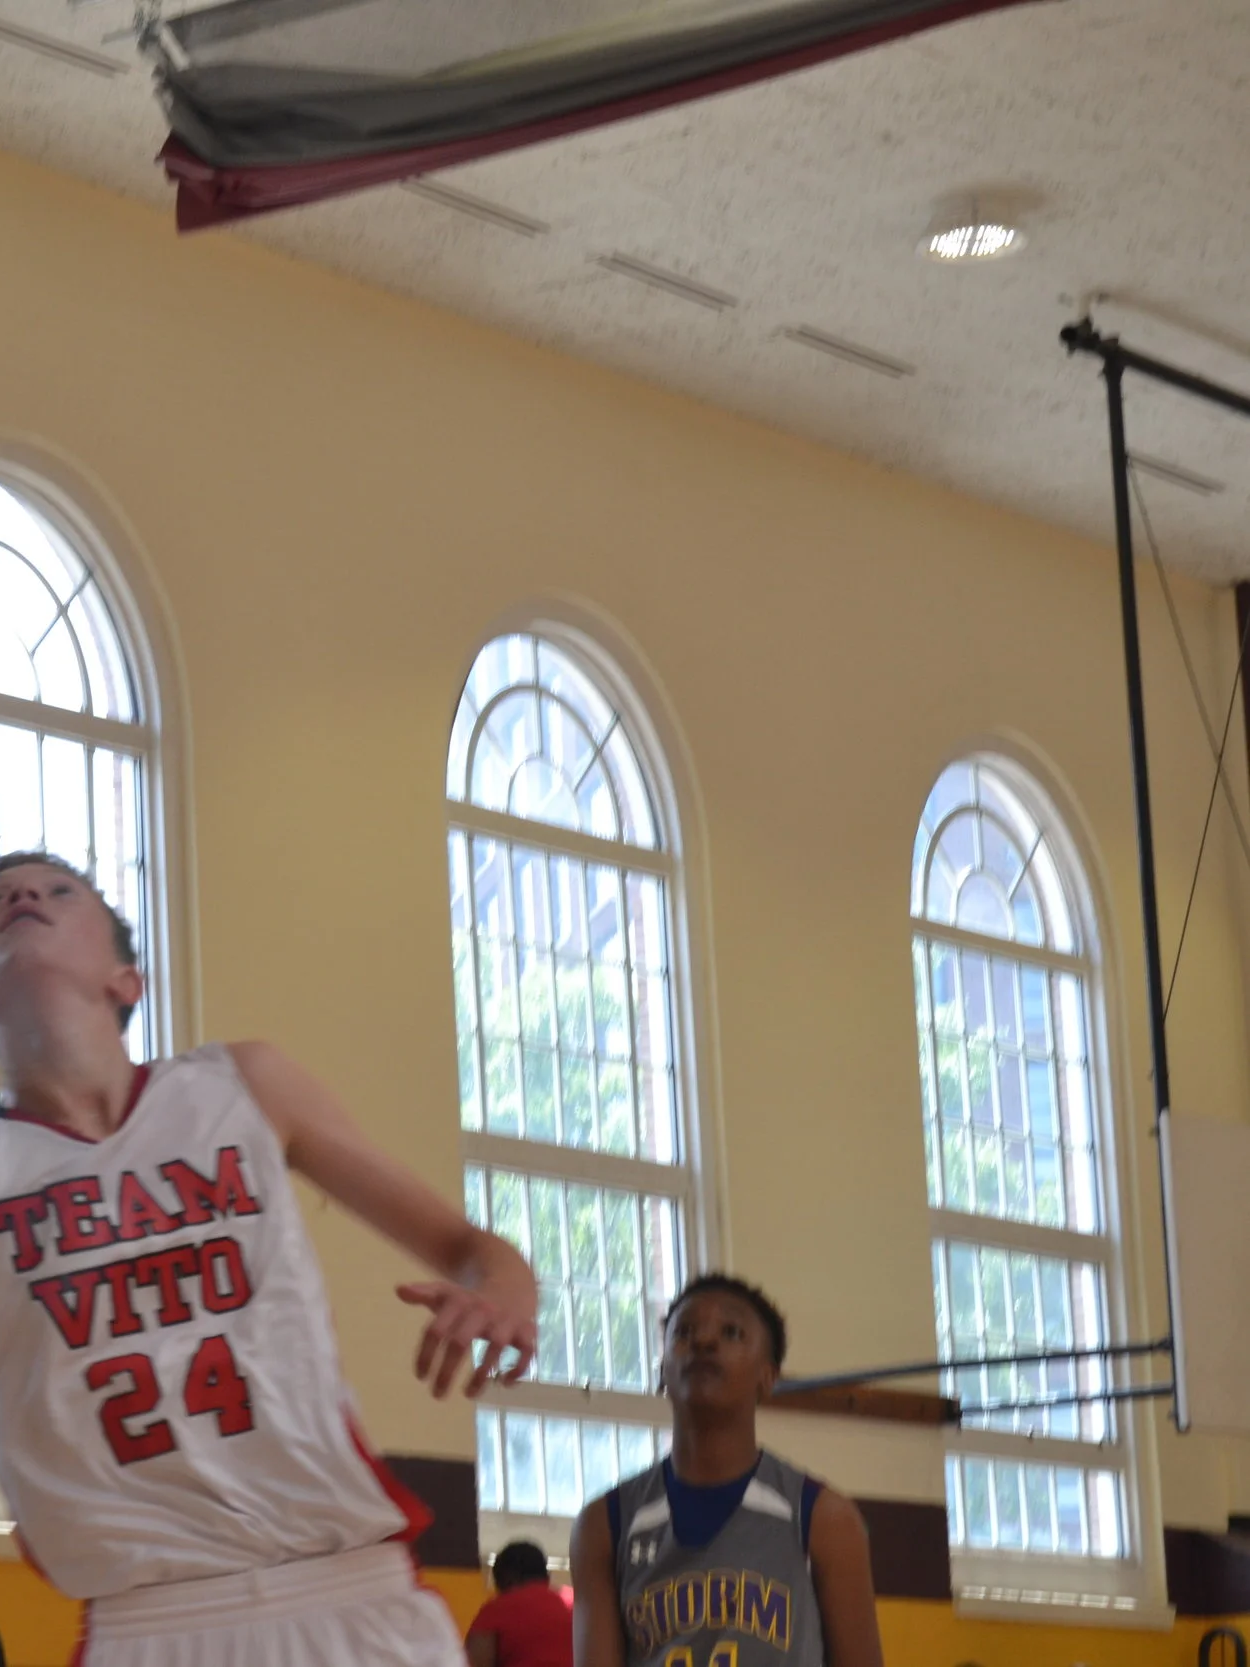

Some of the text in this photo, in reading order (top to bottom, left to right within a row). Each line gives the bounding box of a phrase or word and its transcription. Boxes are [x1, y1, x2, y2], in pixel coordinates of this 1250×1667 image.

[28, 1236, 254, 1350] VITO
[84, 1333, 256, 1467] 24
[626, 1568, 792, 1653] STORM
